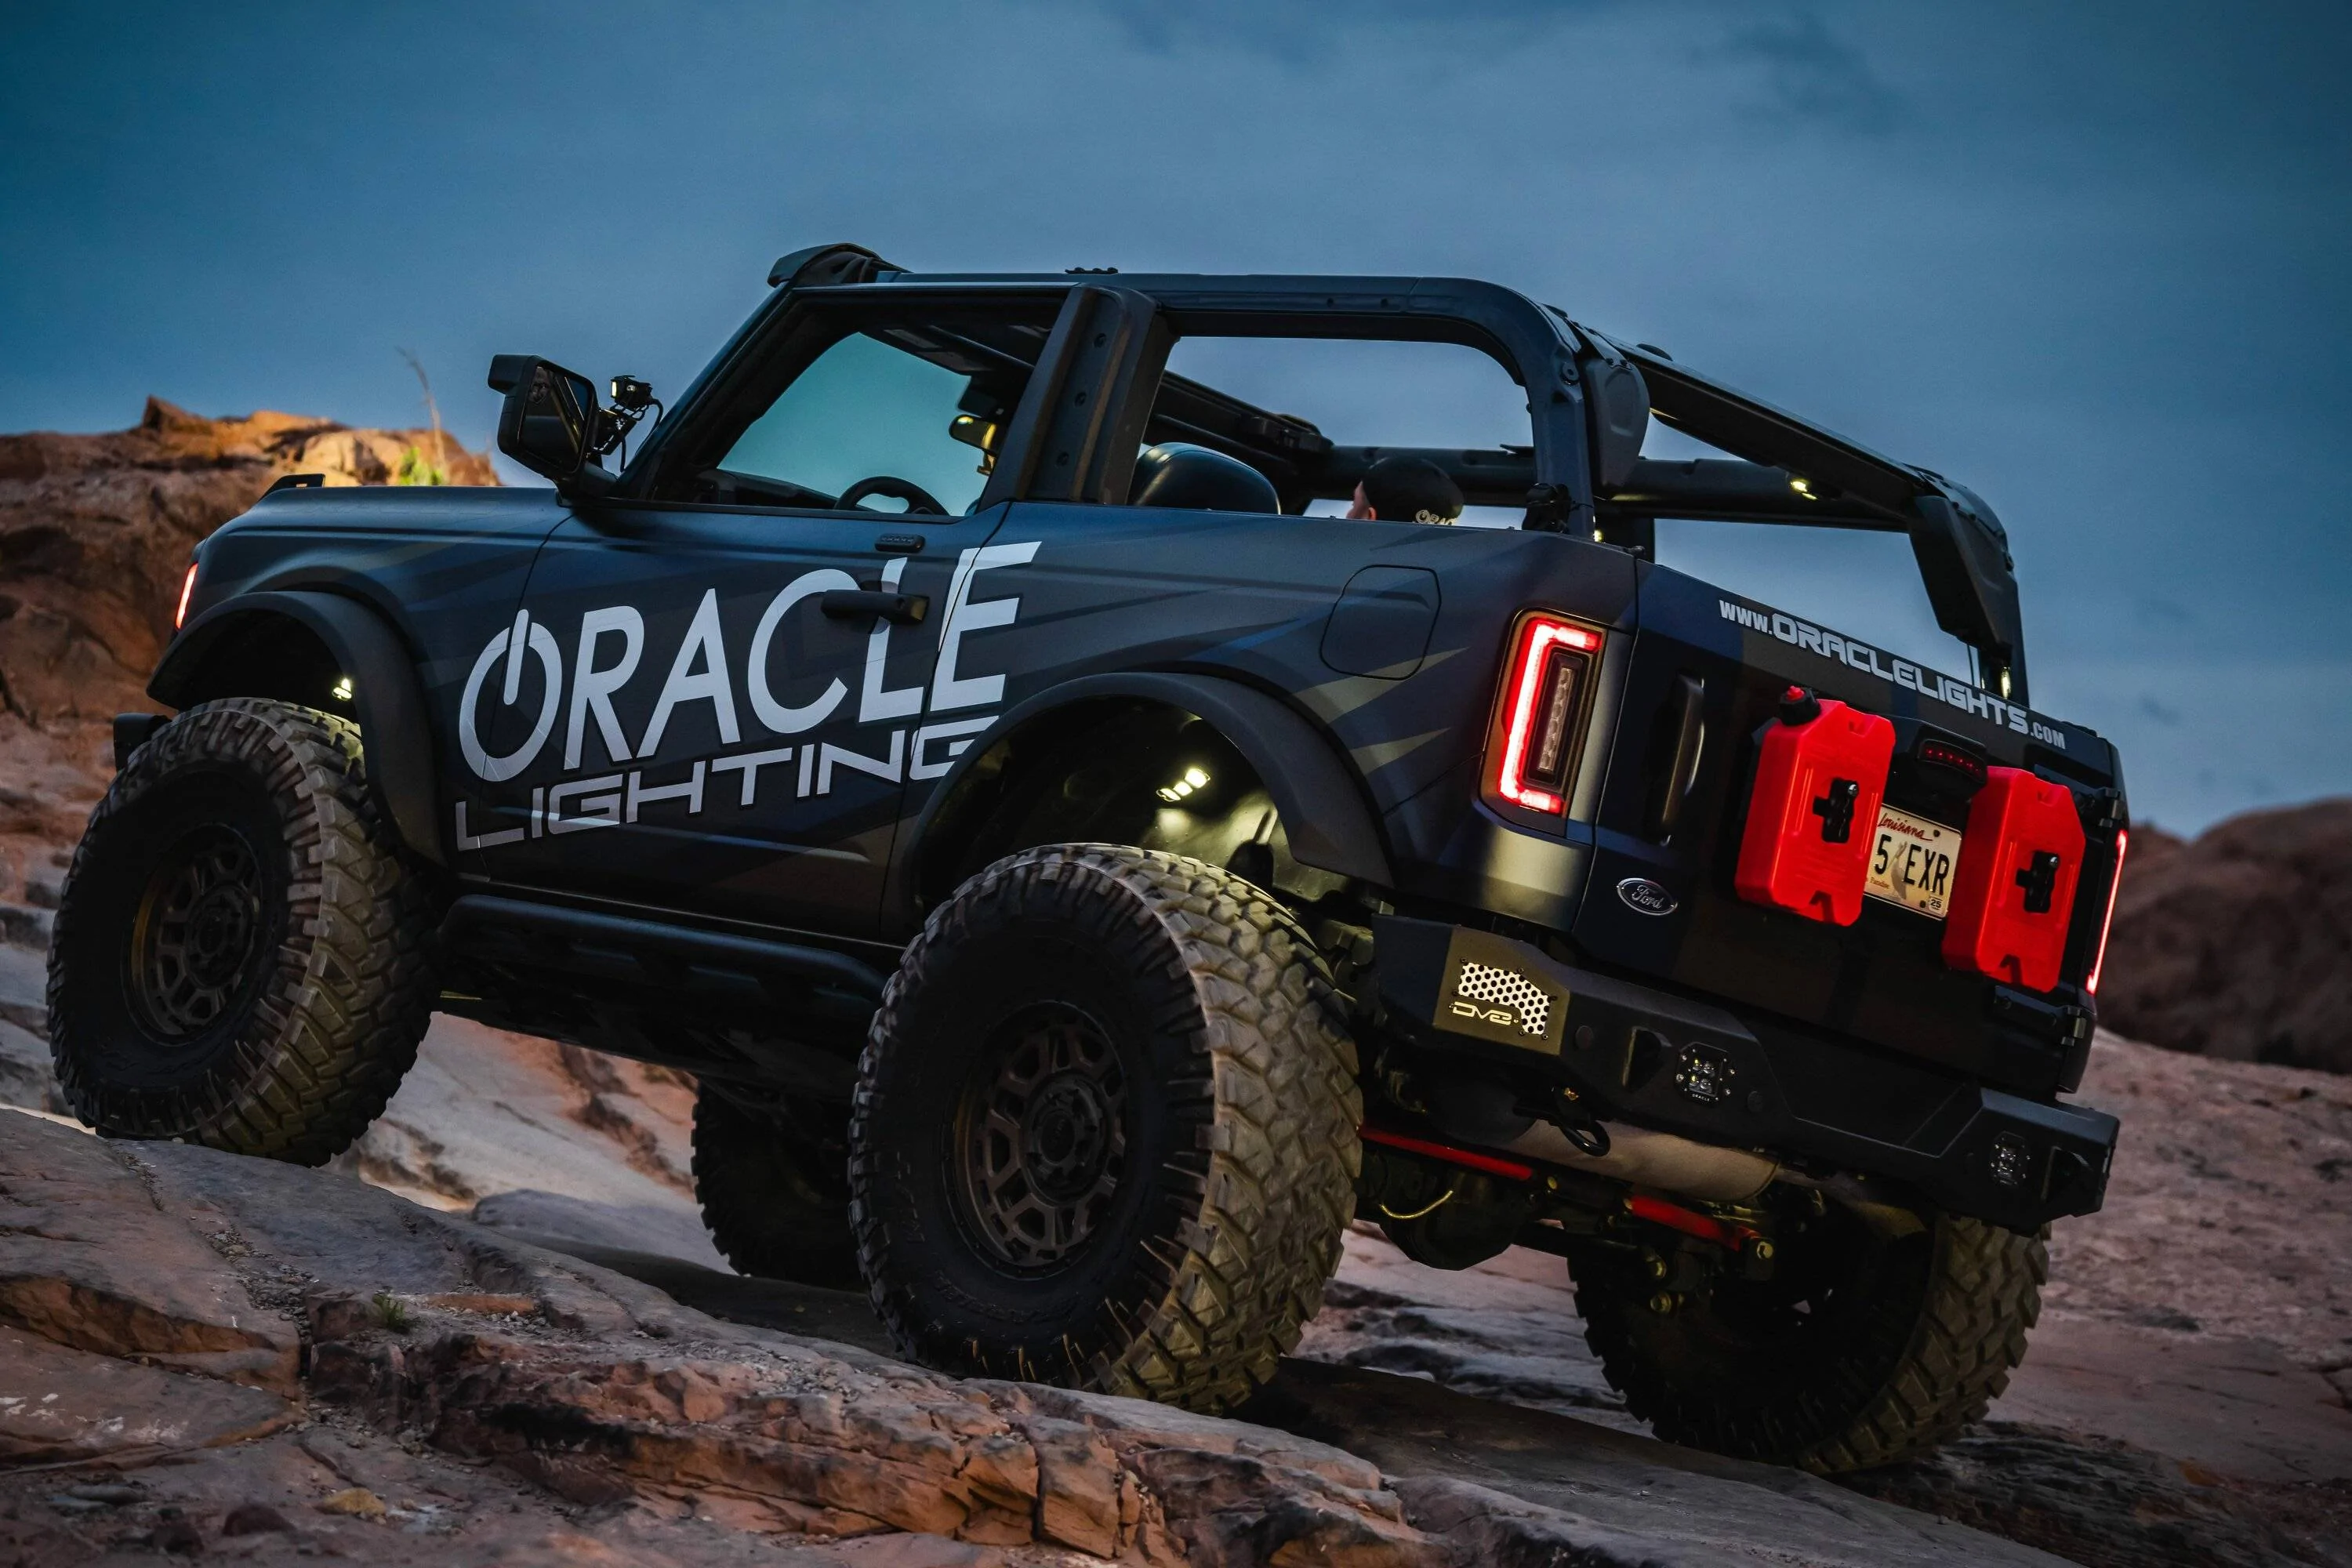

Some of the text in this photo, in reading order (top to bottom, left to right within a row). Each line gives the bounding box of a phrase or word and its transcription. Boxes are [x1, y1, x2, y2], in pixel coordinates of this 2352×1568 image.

[459, 541, 1042, 782] ORACLE
[456, 714, 1000, 851] LIGHTING
[1904, 844, 1950, 895] EXR
[1632, 884, 1664, 909] Ford
[1930, 898, 1942, 909] 25
